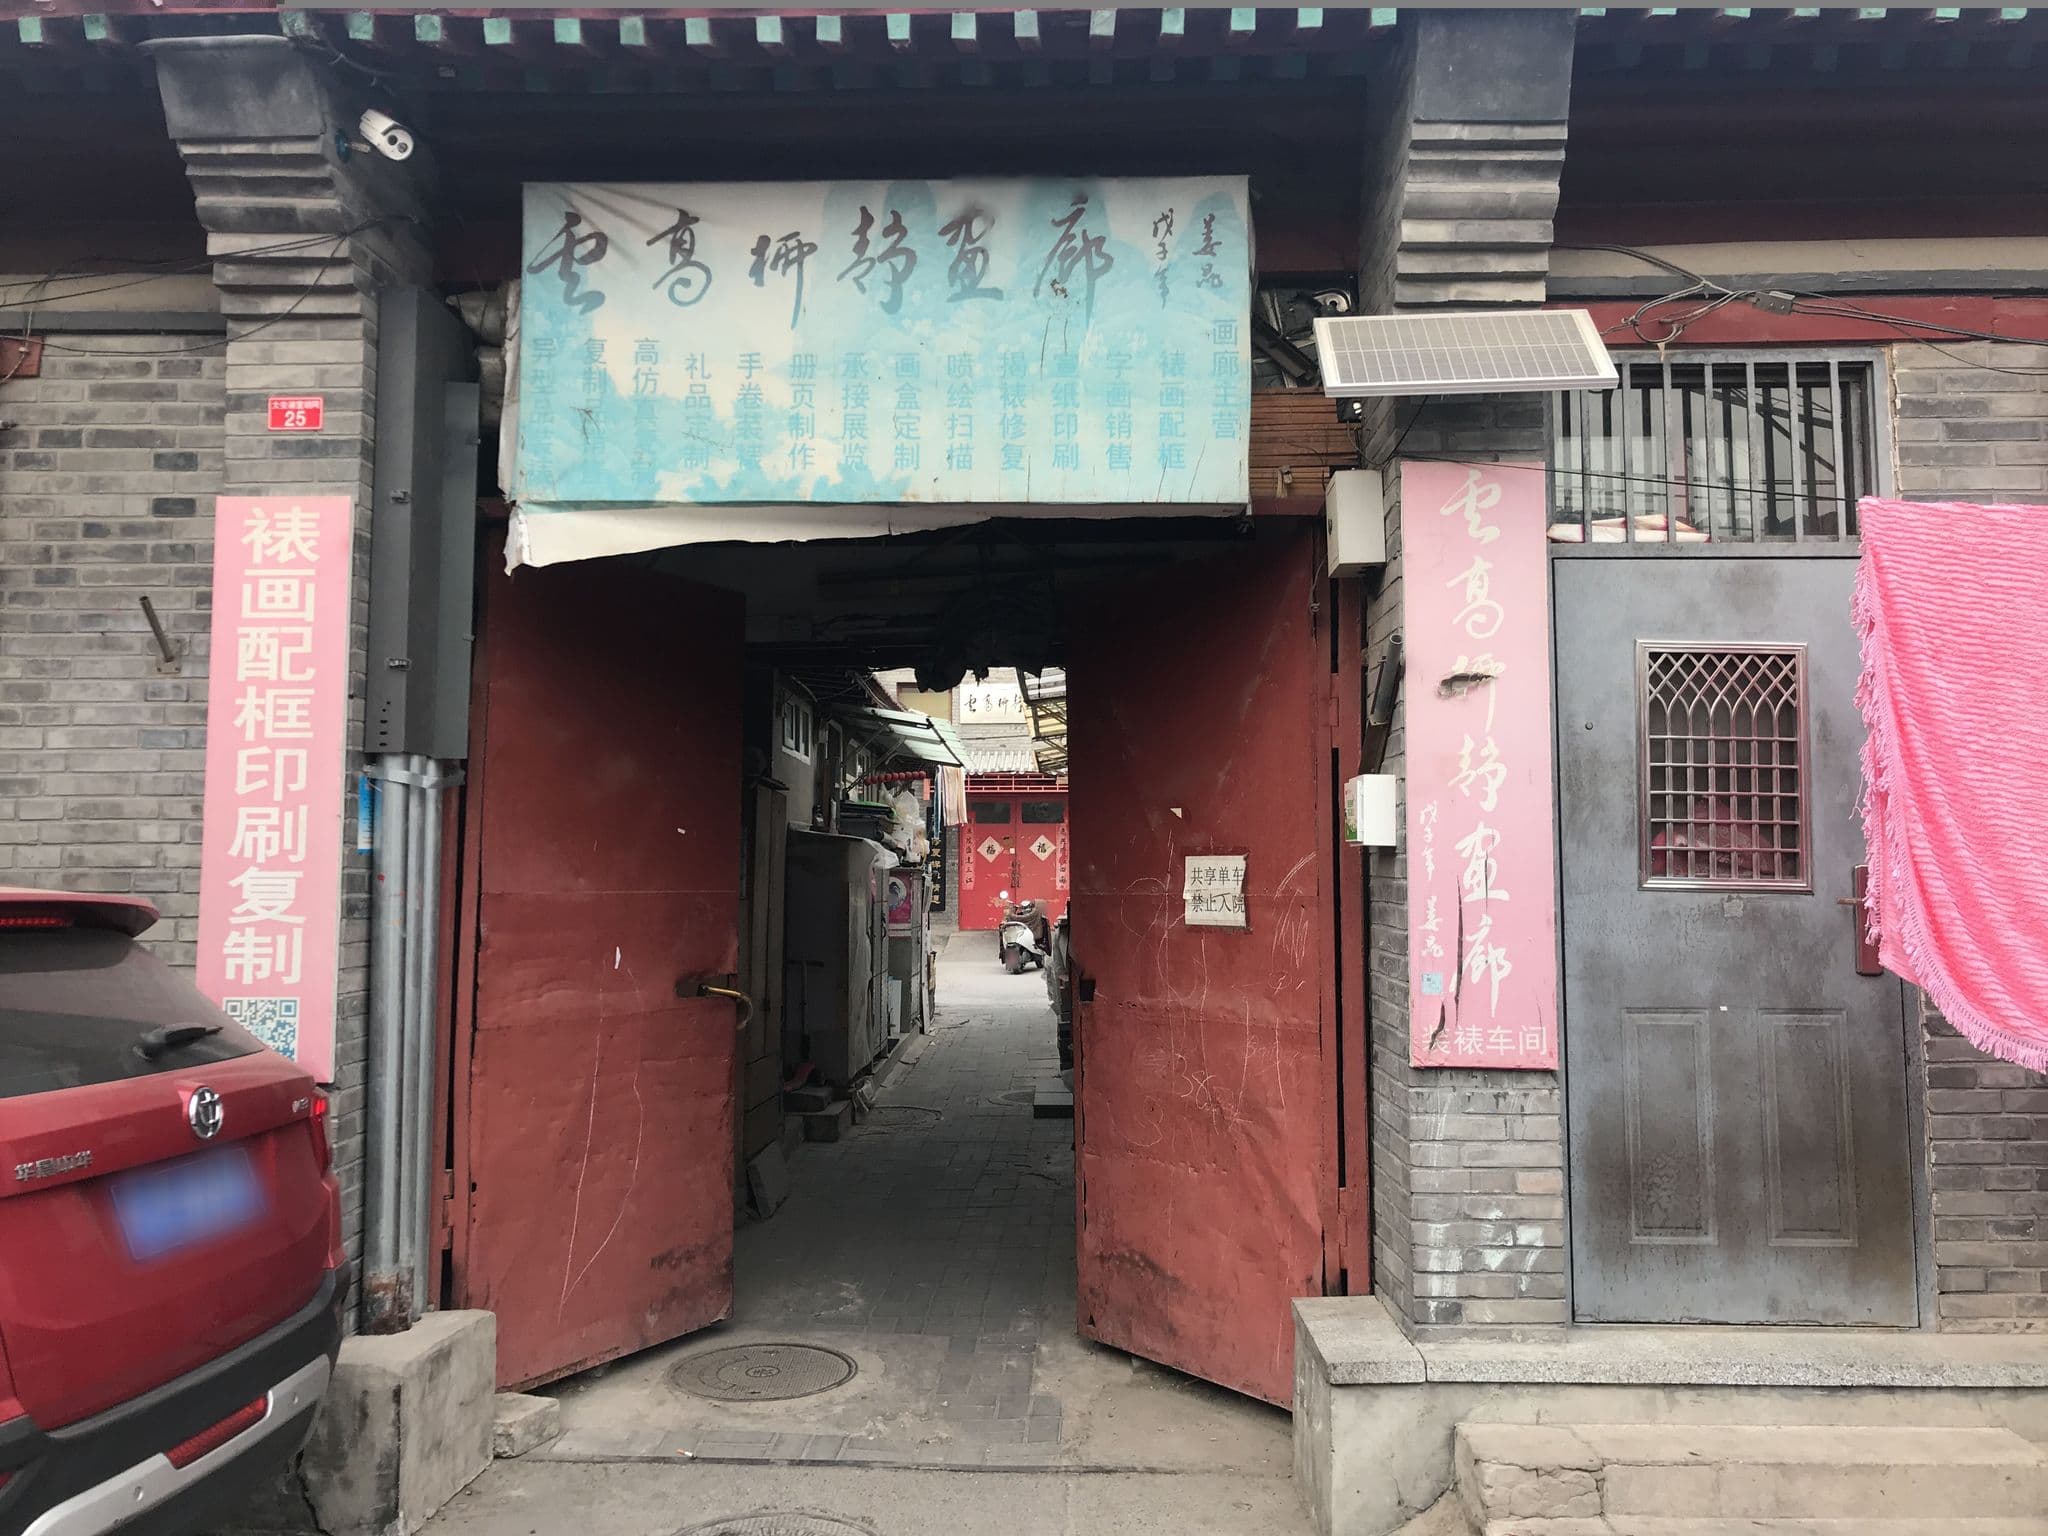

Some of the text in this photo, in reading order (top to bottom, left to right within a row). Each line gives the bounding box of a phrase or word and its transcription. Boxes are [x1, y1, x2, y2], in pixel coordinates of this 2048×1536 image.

[285, 411, 307, 427] 25
[683, 352, 712, 471] 礼品定制
[788, 352, 817, 471] 册页制作
[842, 352, 870, 471] 承接展览
[894, 352, 921, 471] 画盒定制
[946, 352, 974, 471] 喷绘扫描
[1000, 351, 1027, 471] 揭裱修复
[1052, 350, 1080, 471] 宣纸印刷
[1105, 351, 1134, 471] 字画销售
[1158, 350, 1187, 470] 裱画配框
[1212, 319, 1240, 440] 画廊主营
[222, 505, 321, 985] 裱画配框印刷复制
[1191, 866, 1244, 887] 共享单车
[1191, 893, 1245, 913] 禁止入院
[1420, 1025, 1548, 1057] 装裱车间
